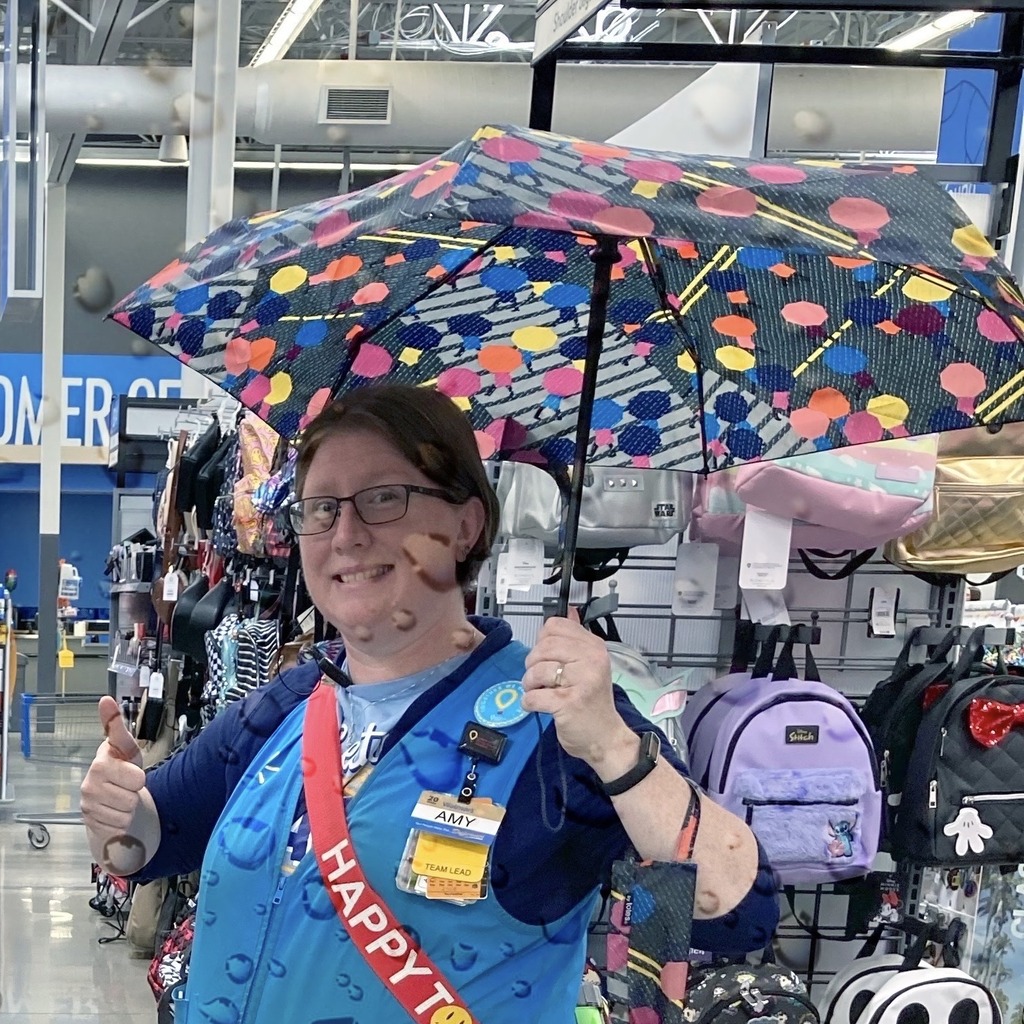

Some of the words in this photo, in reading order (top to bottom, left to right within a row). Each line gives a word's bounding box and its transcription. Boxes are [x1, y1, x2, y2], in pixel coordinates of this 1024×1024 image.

[654, 503, 675, 511] STAR
[654, 510, 675, 518] WARS
[789, 731, 814, 742] Stitch
[434, 810, 476, 828] AMY
[425, 863, 448, 874] TEAM
[449, 866, 472, 877] LEAD
[321, 838, 433, 986] HAPPY
